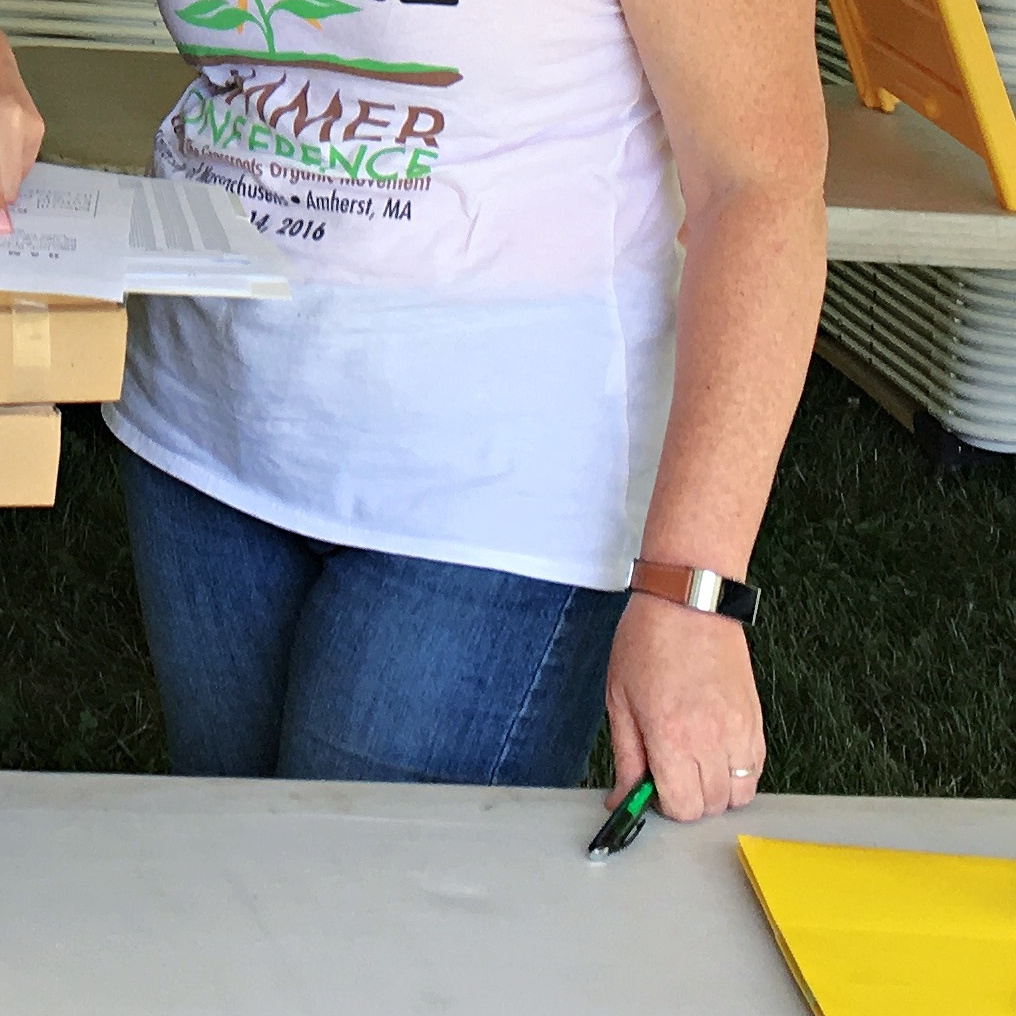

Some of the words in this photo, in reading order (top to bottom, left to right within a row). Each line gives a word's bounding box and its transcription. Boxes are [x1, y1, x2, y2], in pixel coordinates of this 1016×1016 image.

[306, 189, 375, 221] Amherst,
[382, 197, 412, 222] MA
[275, 216, 327, 242] 2016
